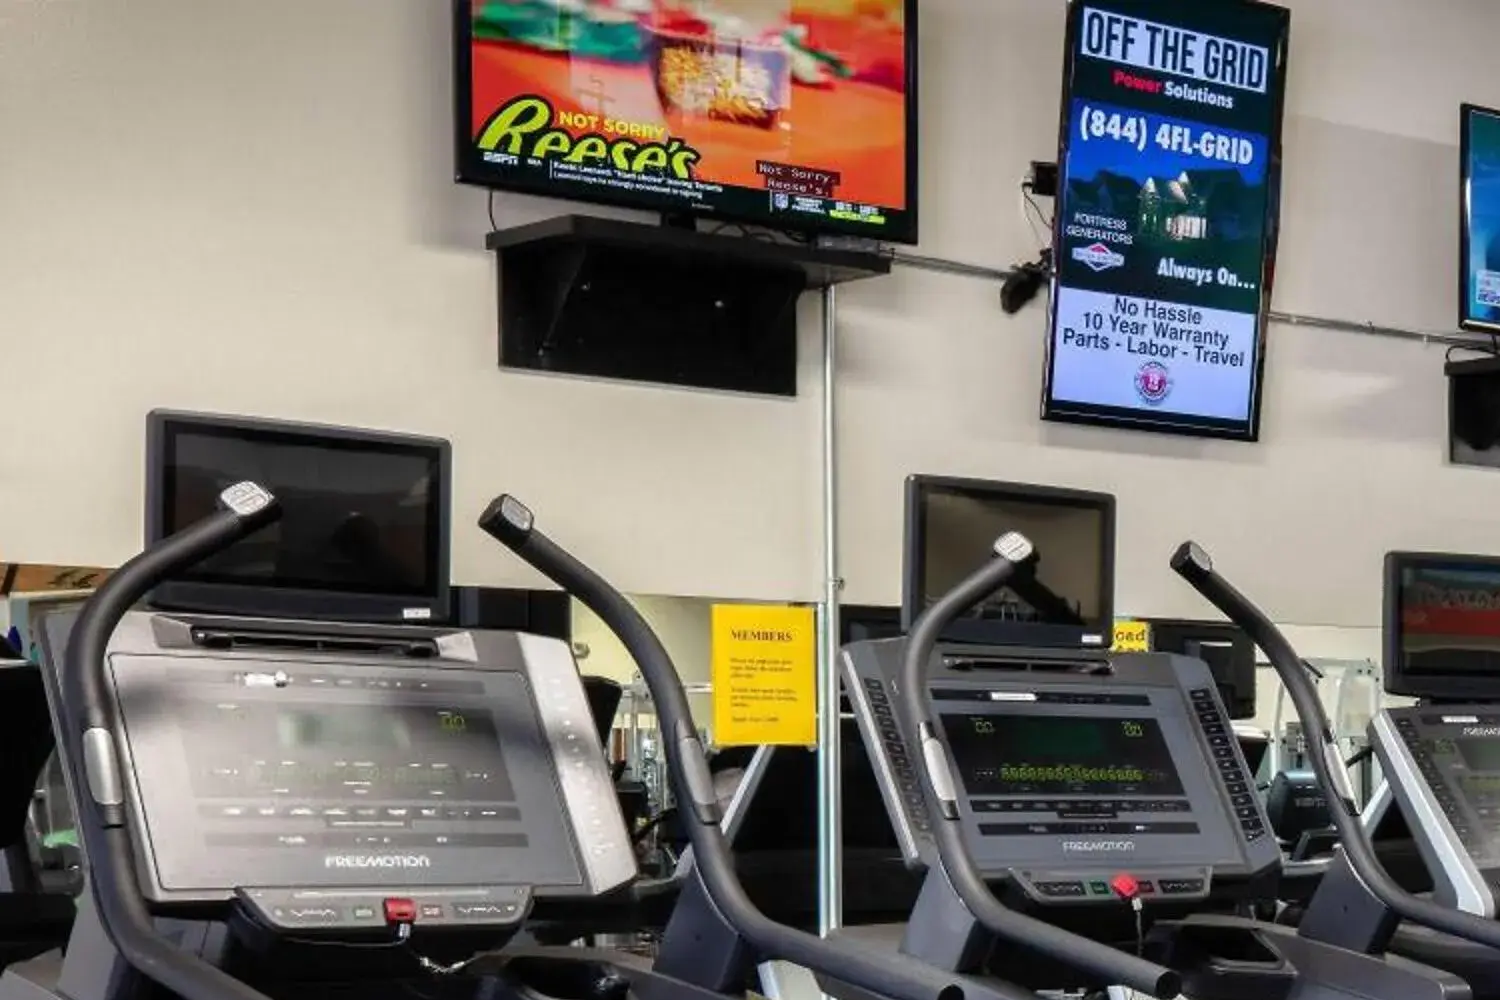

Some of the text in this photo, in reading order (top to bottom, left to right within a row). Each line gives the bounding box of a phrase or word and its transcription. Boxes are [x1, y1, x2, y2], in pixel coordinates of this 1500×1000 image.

[1086, 12, 1264, 87] OFF THE GRID
[1113, 71, 1234, 109] Power Solutions
[478, 98, 697, 179] Reese's
[559, 111, 664, 139] NOT SORRY
[1080, 106, 1253, 165] (844) 4FL-GRID
[1156, 257, 1213, 287] Always
[1113, 297, 1202, 325] No Hassle
[1063, 328, 1110, 351] Parts
[1126, 336, 1178, 358] Labor
[1194, 347, 1244, 367] Travel
[1083, 311, 1229, 351] 10 Year Warranty
[730, 629, 793, 642] MEMBERS
[324, 854, 431, 868] FREEMOTION
